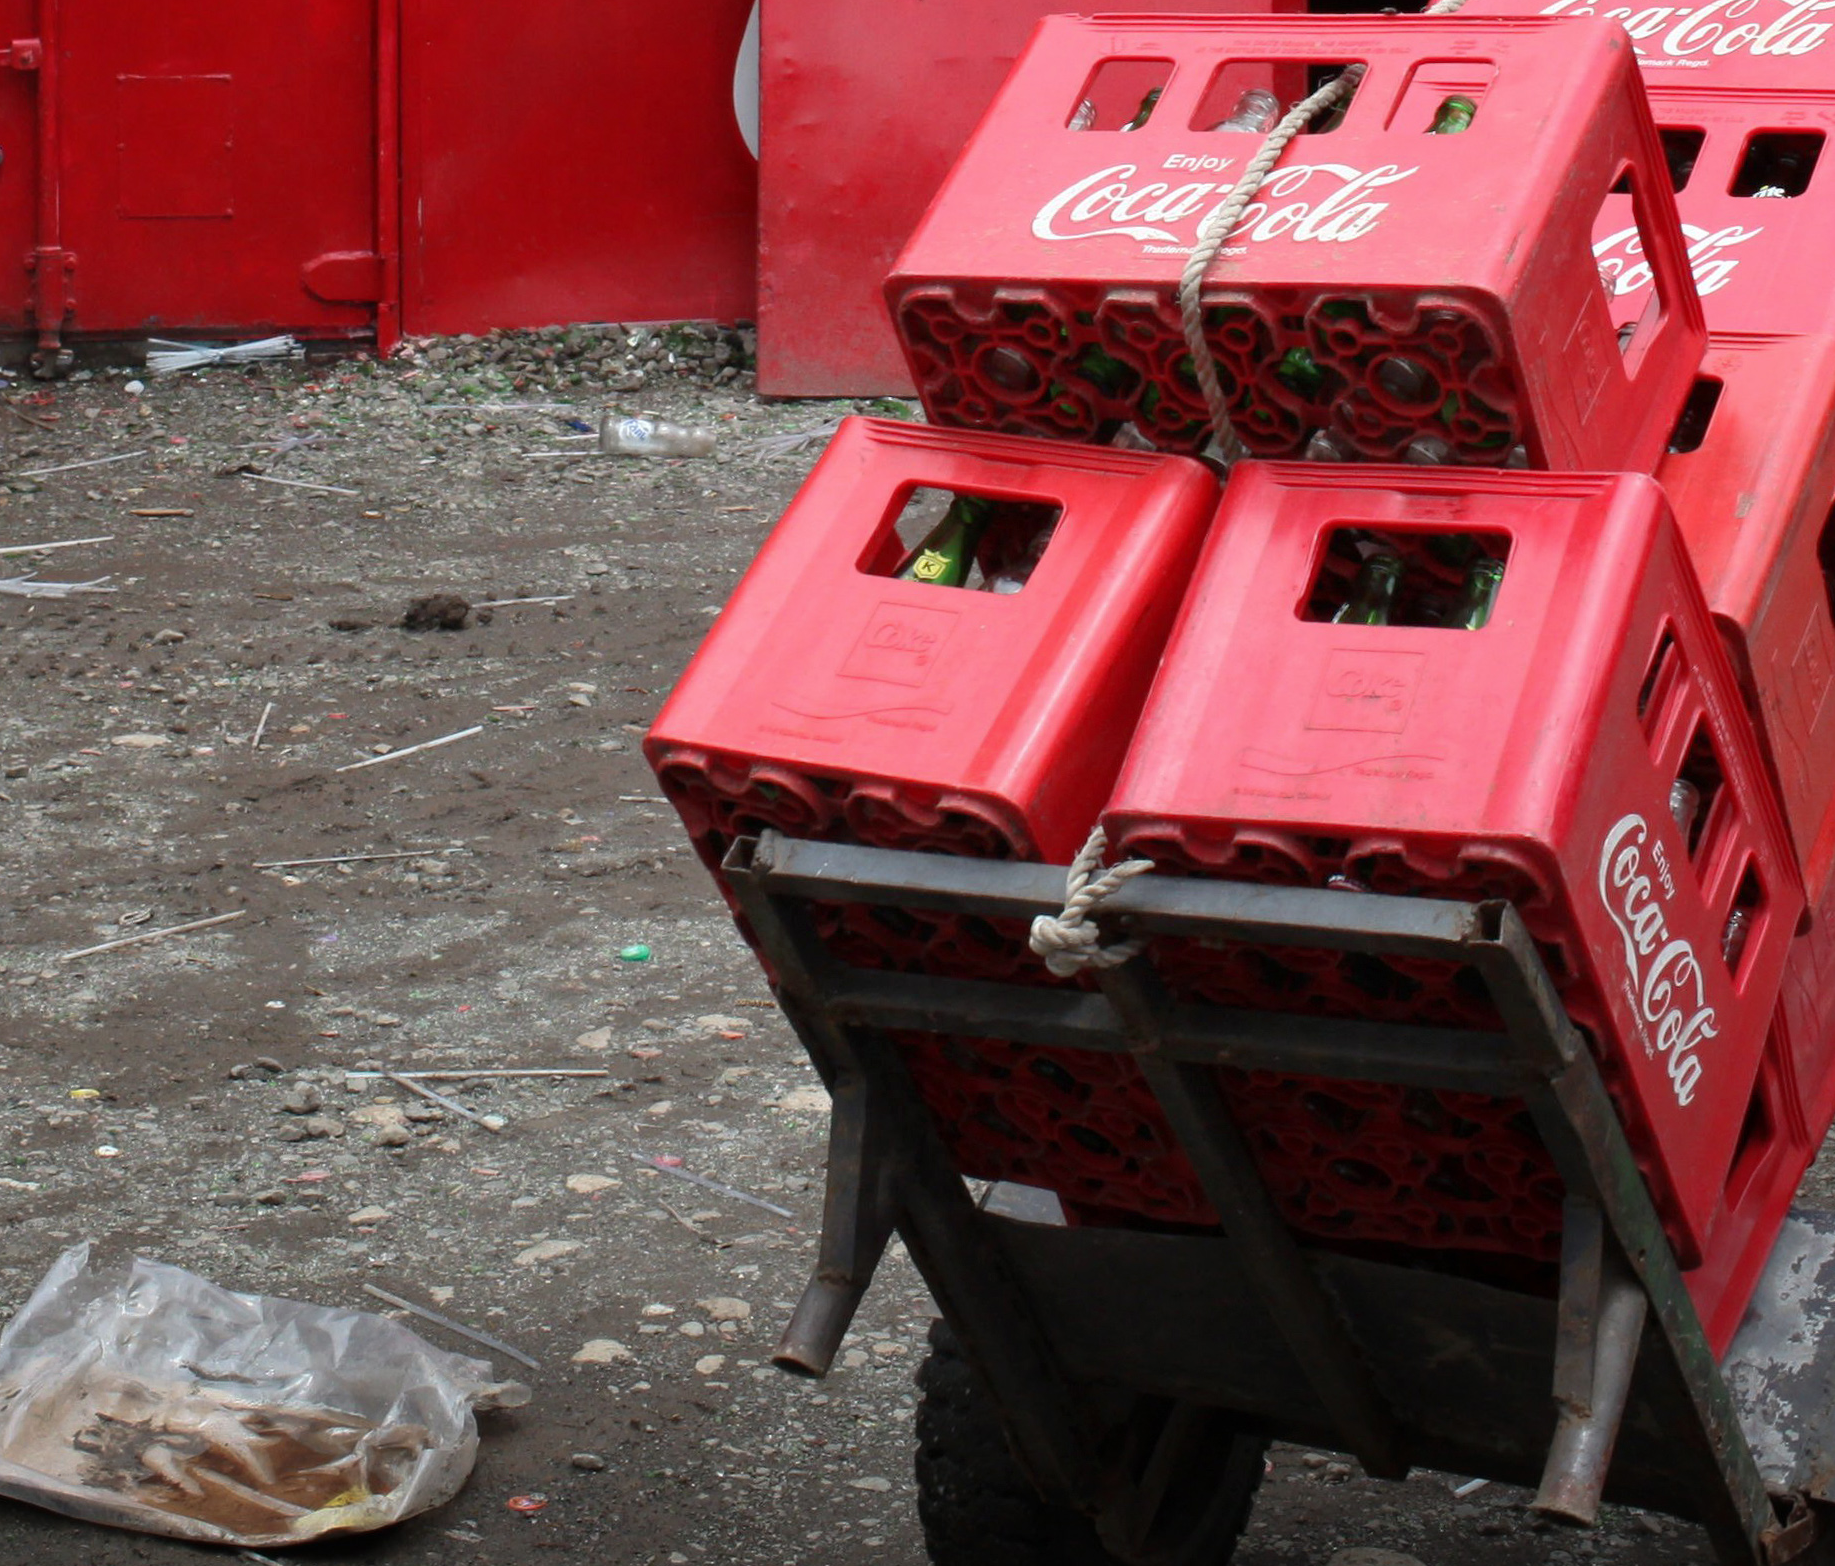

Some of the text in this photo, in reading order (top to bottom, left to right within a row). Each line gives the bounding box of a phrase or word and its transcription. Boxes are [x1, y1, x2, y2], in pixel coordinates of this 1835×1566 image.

[1162, 153, 1235, 172] Enjoy
[1651, 839, 1677, 900] Enjoy
[1599, 814, 1719, 1107] Coca-Cola
